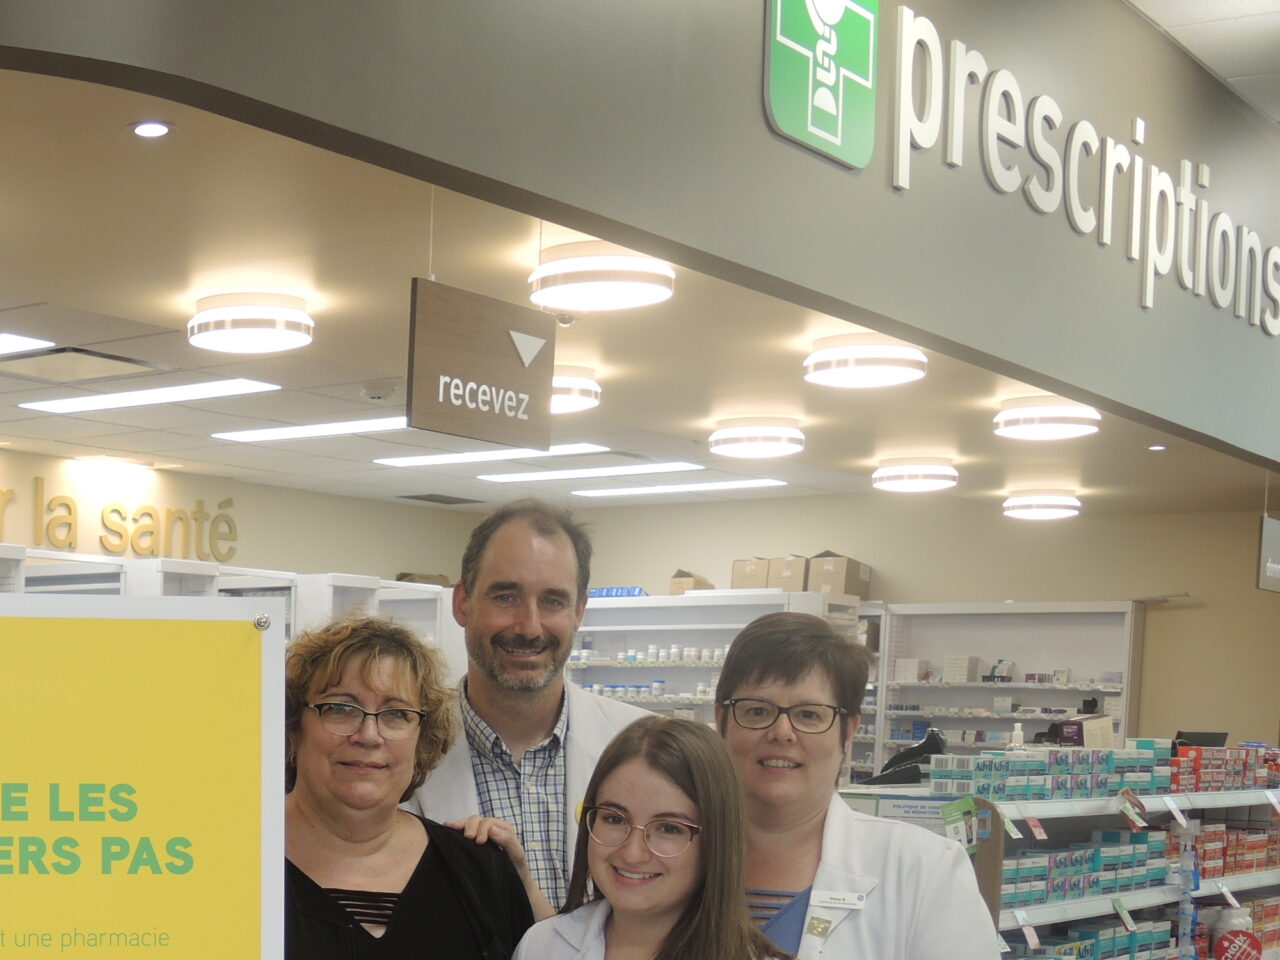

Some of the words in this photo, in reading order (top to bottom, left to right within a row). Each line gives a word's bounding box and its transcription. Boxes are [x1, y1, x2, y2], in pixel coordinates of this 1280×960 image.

[892, 5, 1280, 336] prescriptions
[437, 374, 529, 420] recevez
[34, 476, 78, 549] la
[99, 497, 239, 562] santé
[49, 783, 139, 822] LES
[101, 836, 194, 875] PAS
[15, 933, 52, 947] une
[61, 928, 170, 952] pharmacie
